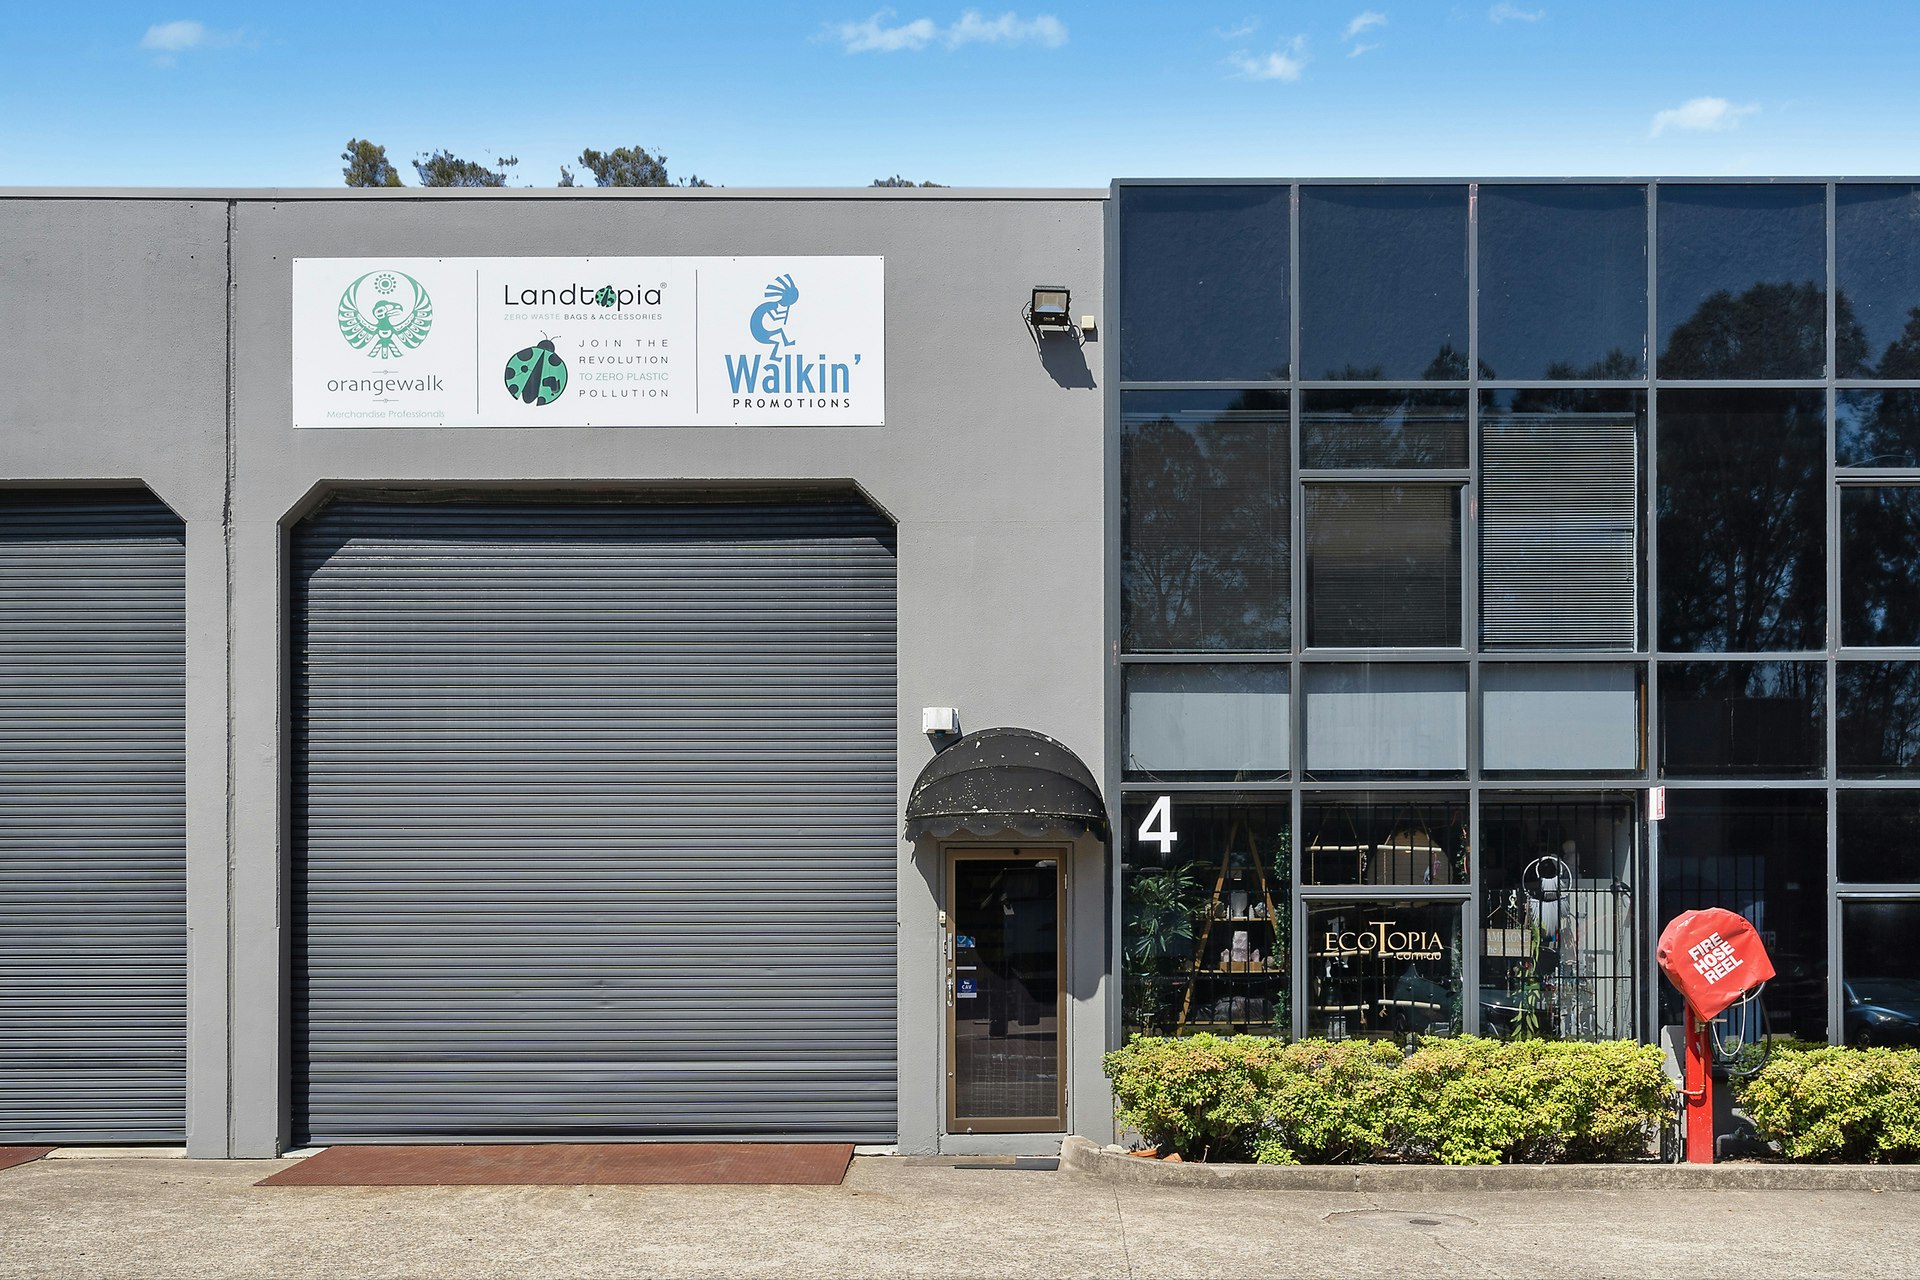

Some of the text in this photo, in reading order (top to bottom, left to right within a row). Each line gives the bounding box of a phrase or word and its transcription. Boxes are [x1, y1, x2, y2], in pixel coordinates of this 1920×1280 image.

[504, 313, 663, 321] ZERO WASTE BAGS & ACCESSORIES
[578, 339, 669, 348] JOIN THE
[579, 356, 669, 365] REVOLUTION
[579, 372, 669, 381] TO ZERO PLASTIC
[327, 374, 444, 396] orangewalk
[579, 389, 669, 398] POLLUTION
[733, 398, 850, 409] PROMOTIONS
[327, 409, 445, 419] Merchandise Professionals
[1138, 796, 1177, 852] 4
[1687, 931, 1723, 961] FIRE
[1693, 940, 1735, 975] HOSE
[1703, 955, 1744, 985] REEL
